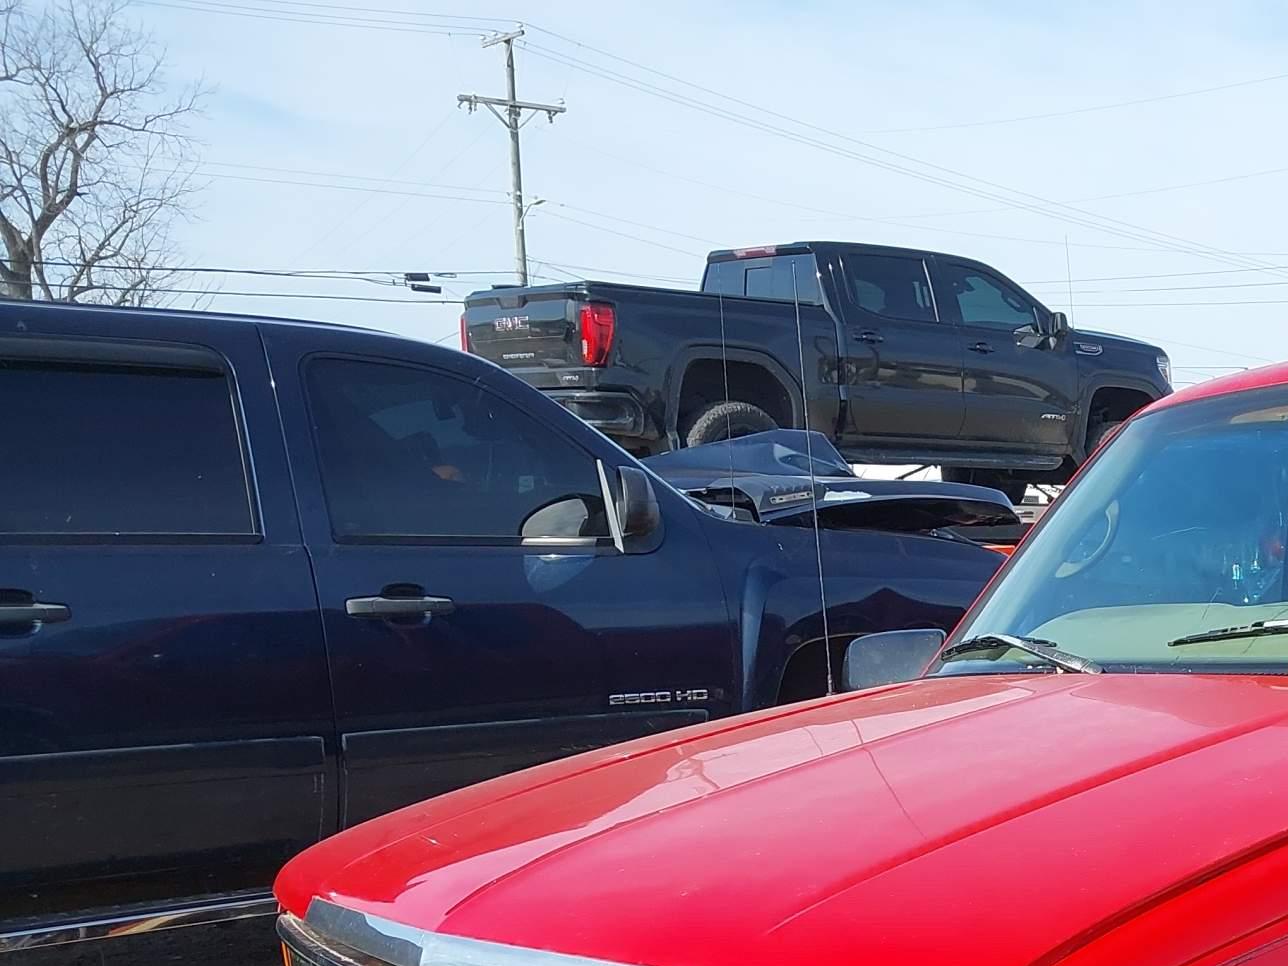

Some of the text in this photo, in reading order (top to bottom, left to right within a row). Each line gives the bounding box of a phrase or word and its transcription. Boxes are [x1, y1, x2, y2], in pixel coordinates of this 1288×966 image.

[495, 315, 529, 332] GMC
[609, 689, 708, 705] 2500 HD
